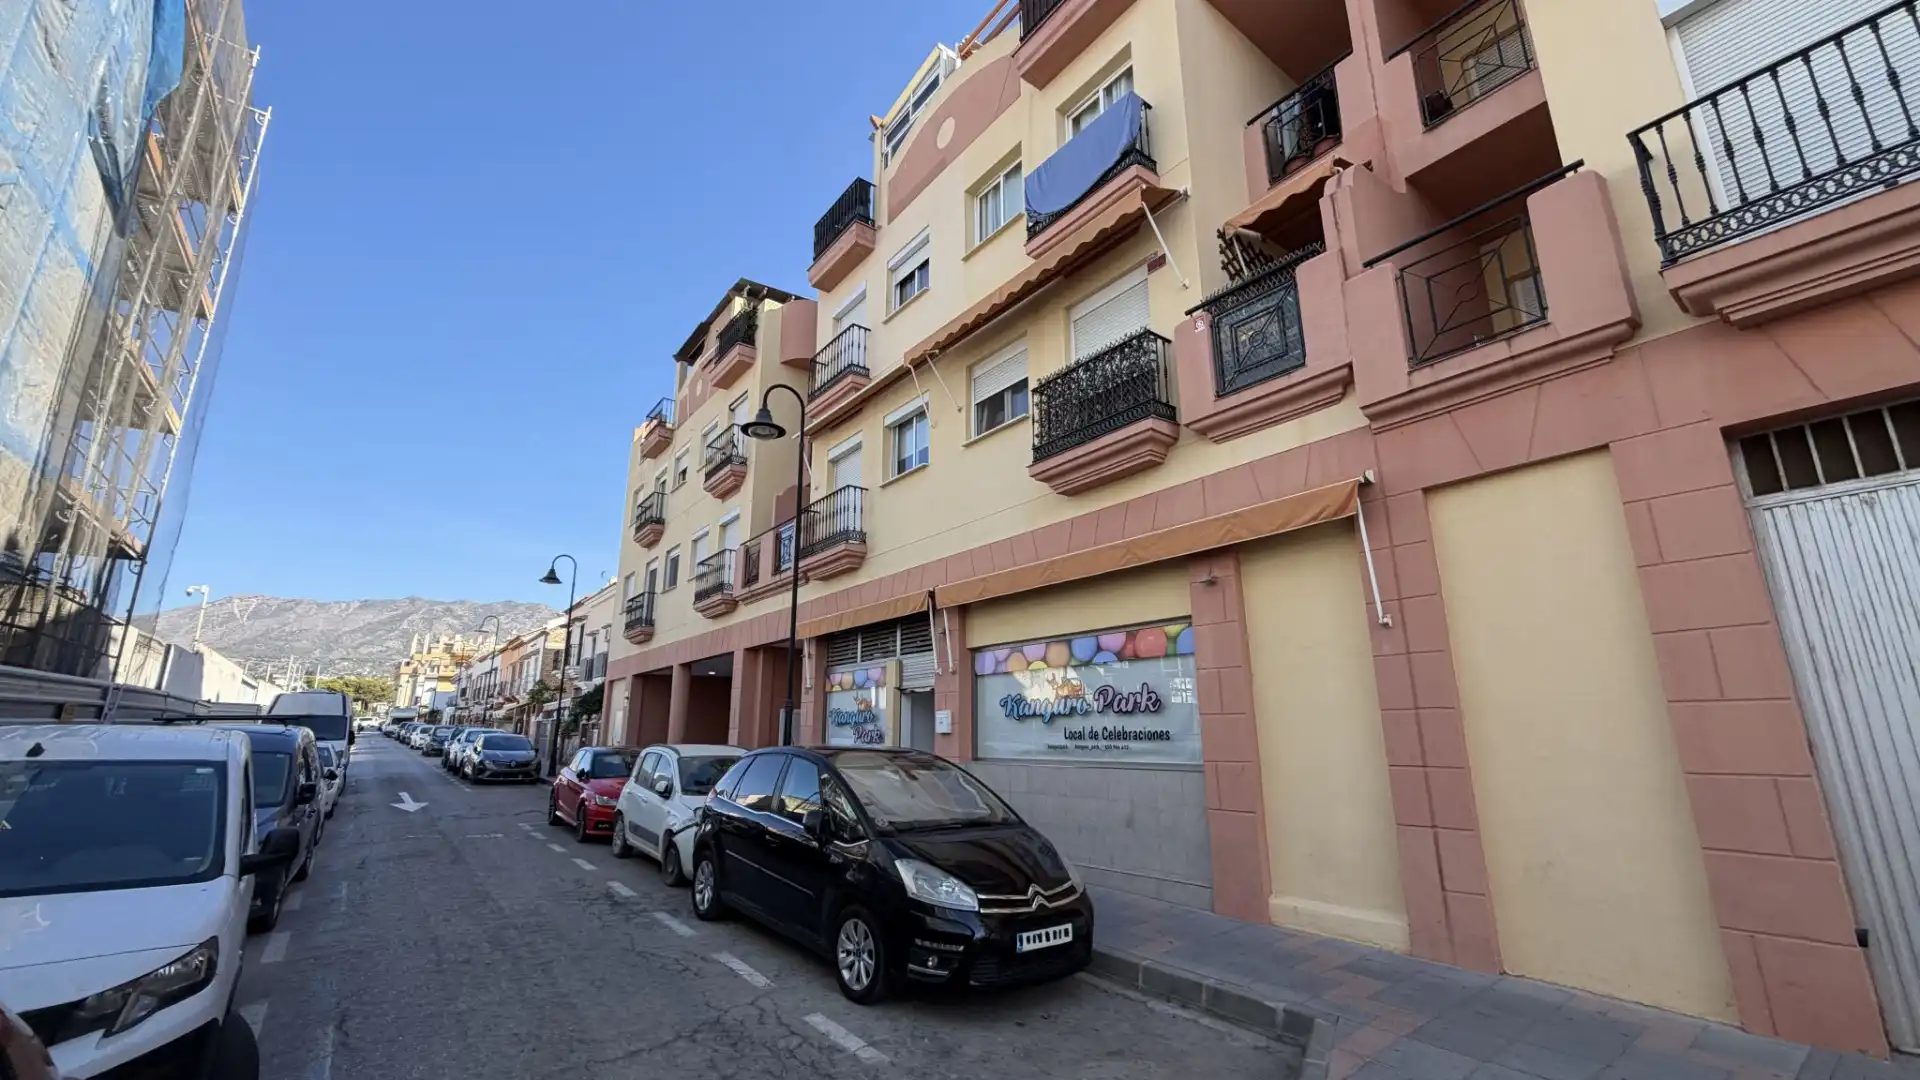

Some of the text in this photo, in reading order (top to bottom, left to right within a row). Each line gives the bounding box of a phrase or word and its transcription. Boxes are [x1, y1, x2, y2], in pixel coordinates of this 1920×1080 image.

[1000, 682, 1161, 724] Kanguro Park
[829, 708, 875, 727] Kanguro
[853, 724, 884, 744] Park
[1064, 725, 1170, 740] Local de Celebraciones
